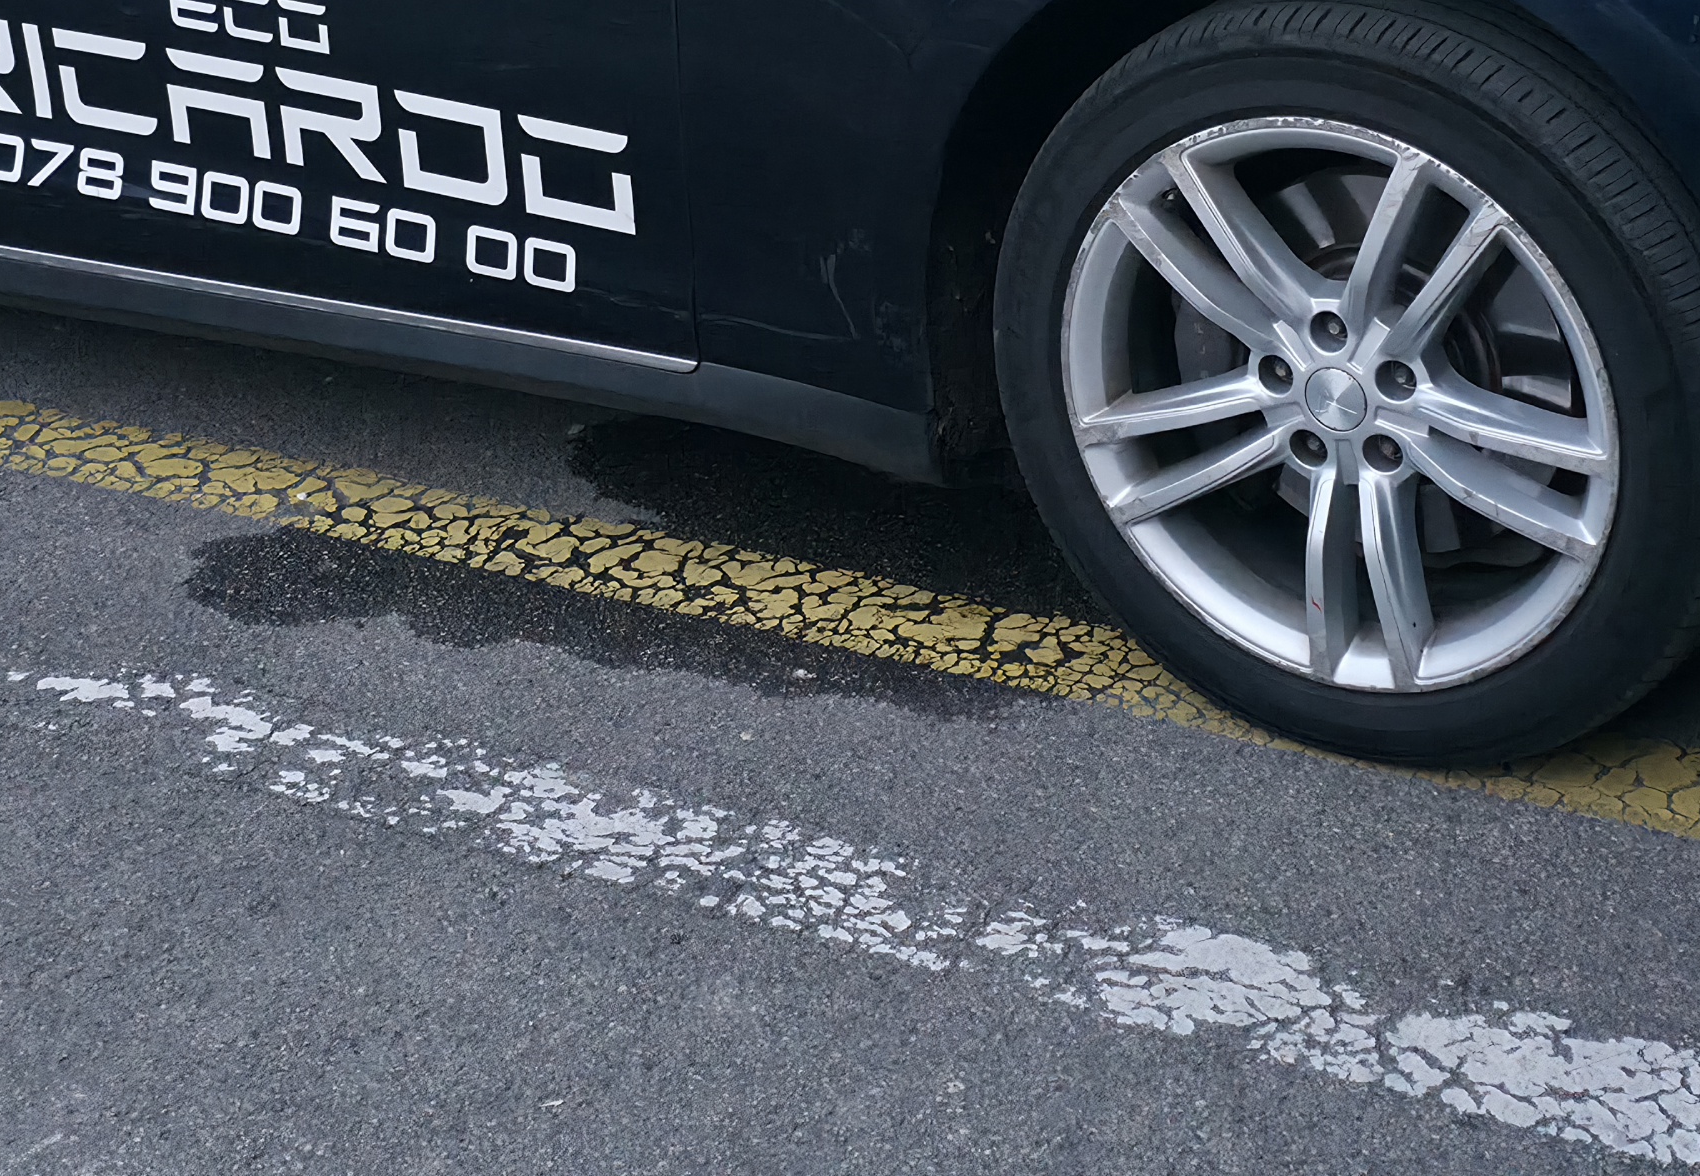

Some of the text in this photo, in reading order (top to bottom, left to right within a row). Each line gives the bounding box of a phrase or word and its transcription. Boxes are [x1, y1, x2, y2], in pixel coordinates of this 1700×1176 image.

[148, 159, 302, 236] 900
[330, 195, 436, 264] 60
[465, 224, 576, 293] 00
